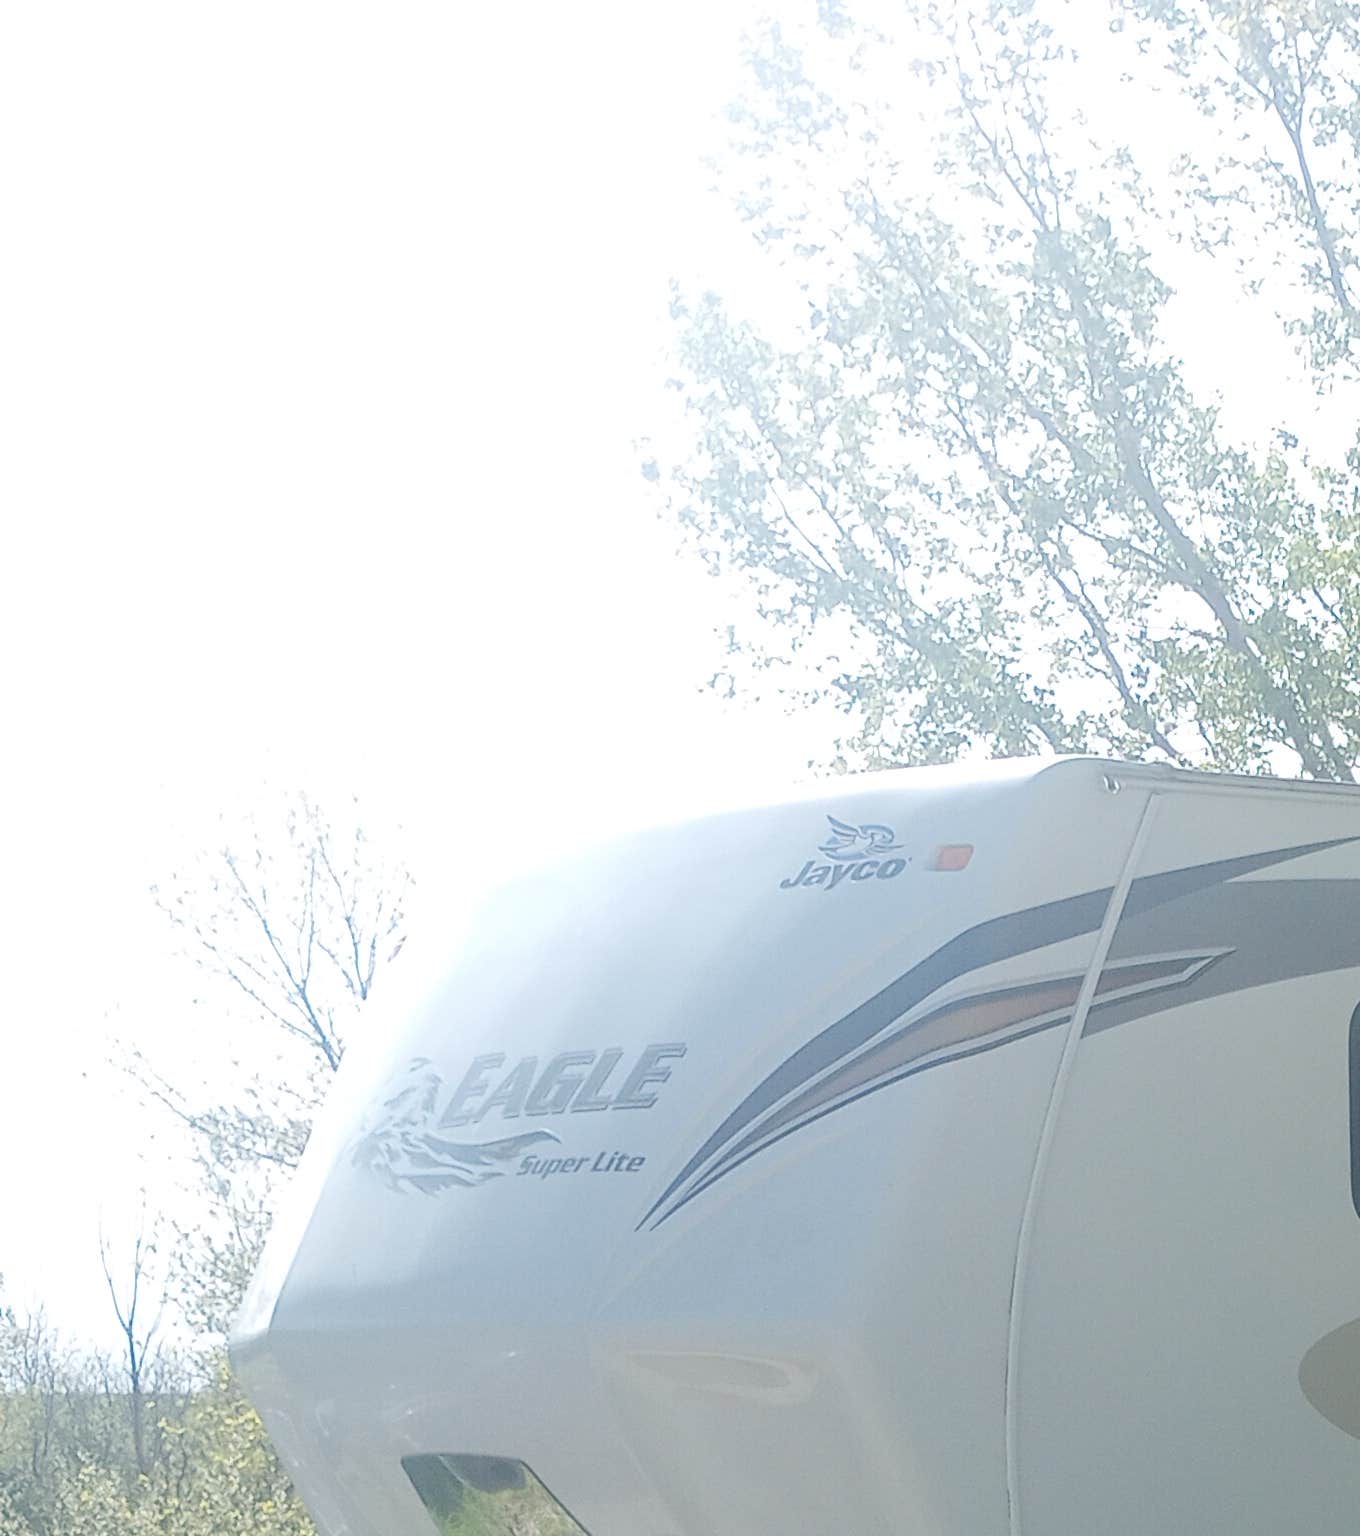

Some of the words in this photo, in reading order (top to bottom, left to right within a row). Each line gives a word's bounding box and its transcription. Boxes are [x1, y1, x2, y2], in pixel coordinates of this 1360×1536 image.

[779, 857, 908, 890] Jayco
[437, 1042, 688, 1128] EAGLE
[516, 1155, 590, 1180] Super
[591, 1151, 646, 1173] Lite
